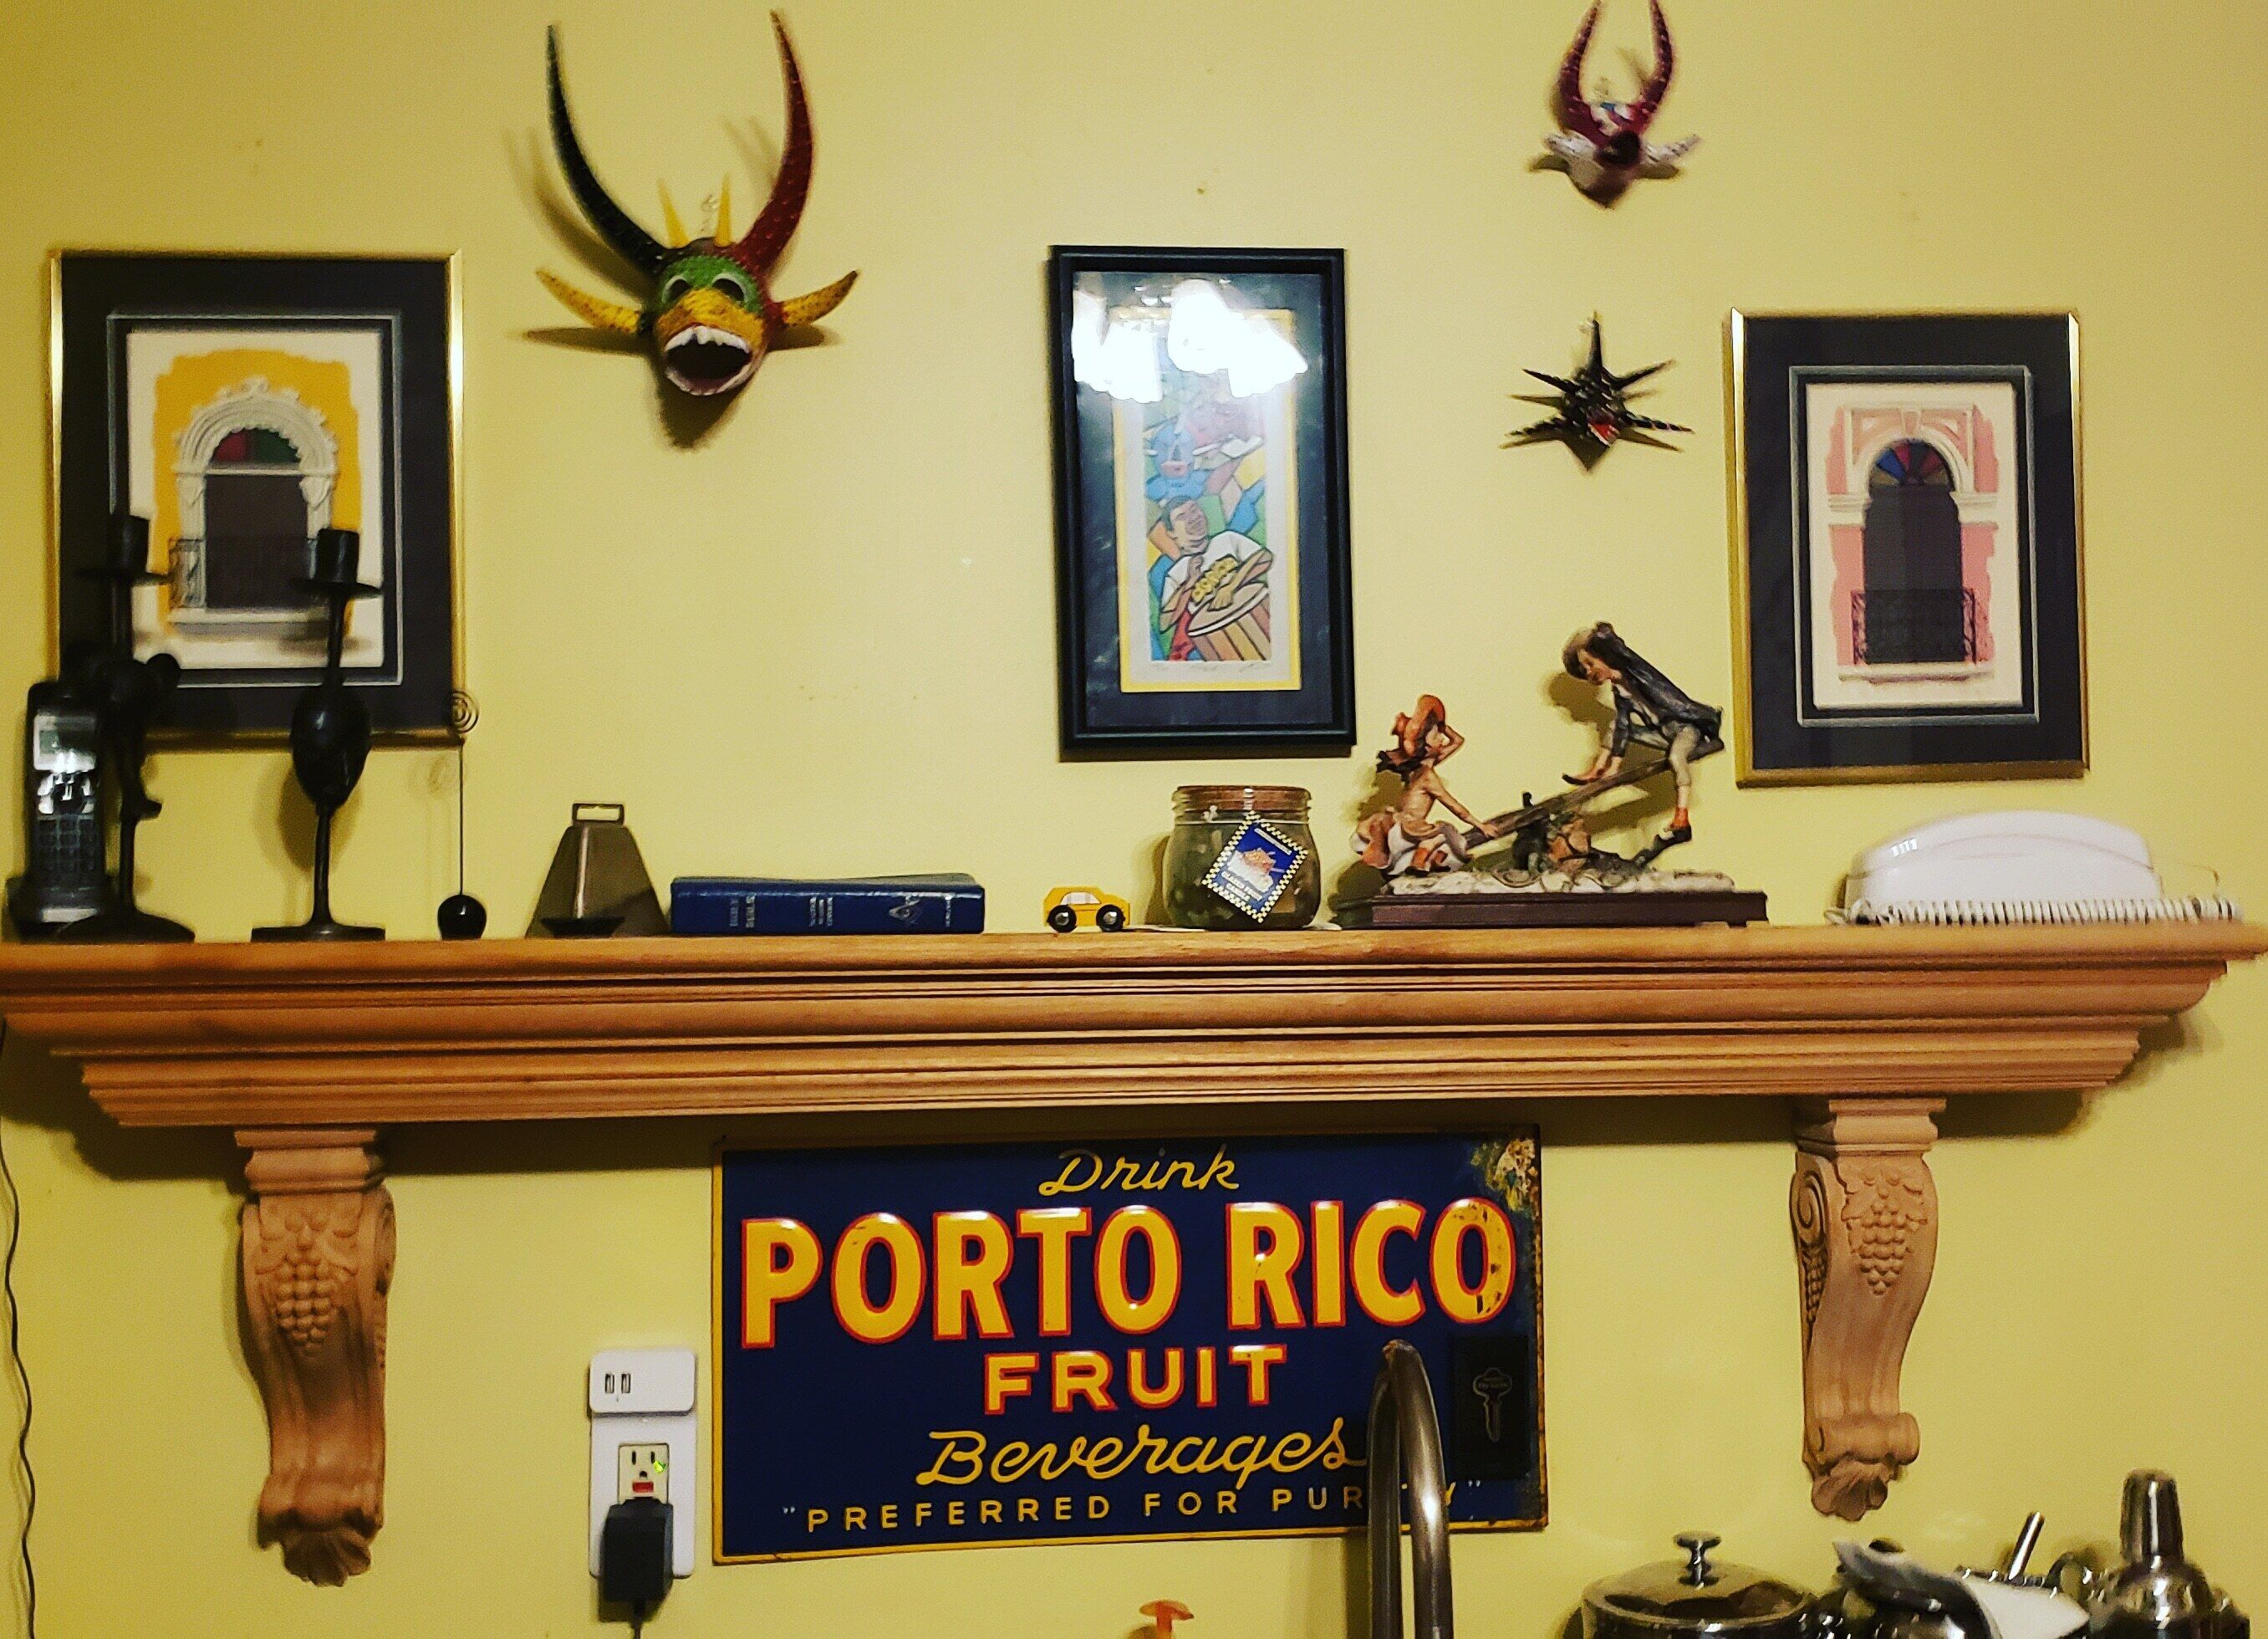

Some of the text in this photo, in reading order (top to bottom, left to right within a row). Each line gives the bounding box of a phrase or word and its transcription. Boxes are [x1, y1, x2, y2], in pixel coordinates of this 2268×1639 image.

[1038, 1143, 1240, 1196] Drink
[741, 1197, 1516, 1349] PORTO RICO
[984, 1343, 1288, 1416] FRUIT
[915, 1417, 1367, 1490] Beverages
[1144, 1491, 1238, 1517] FOR
